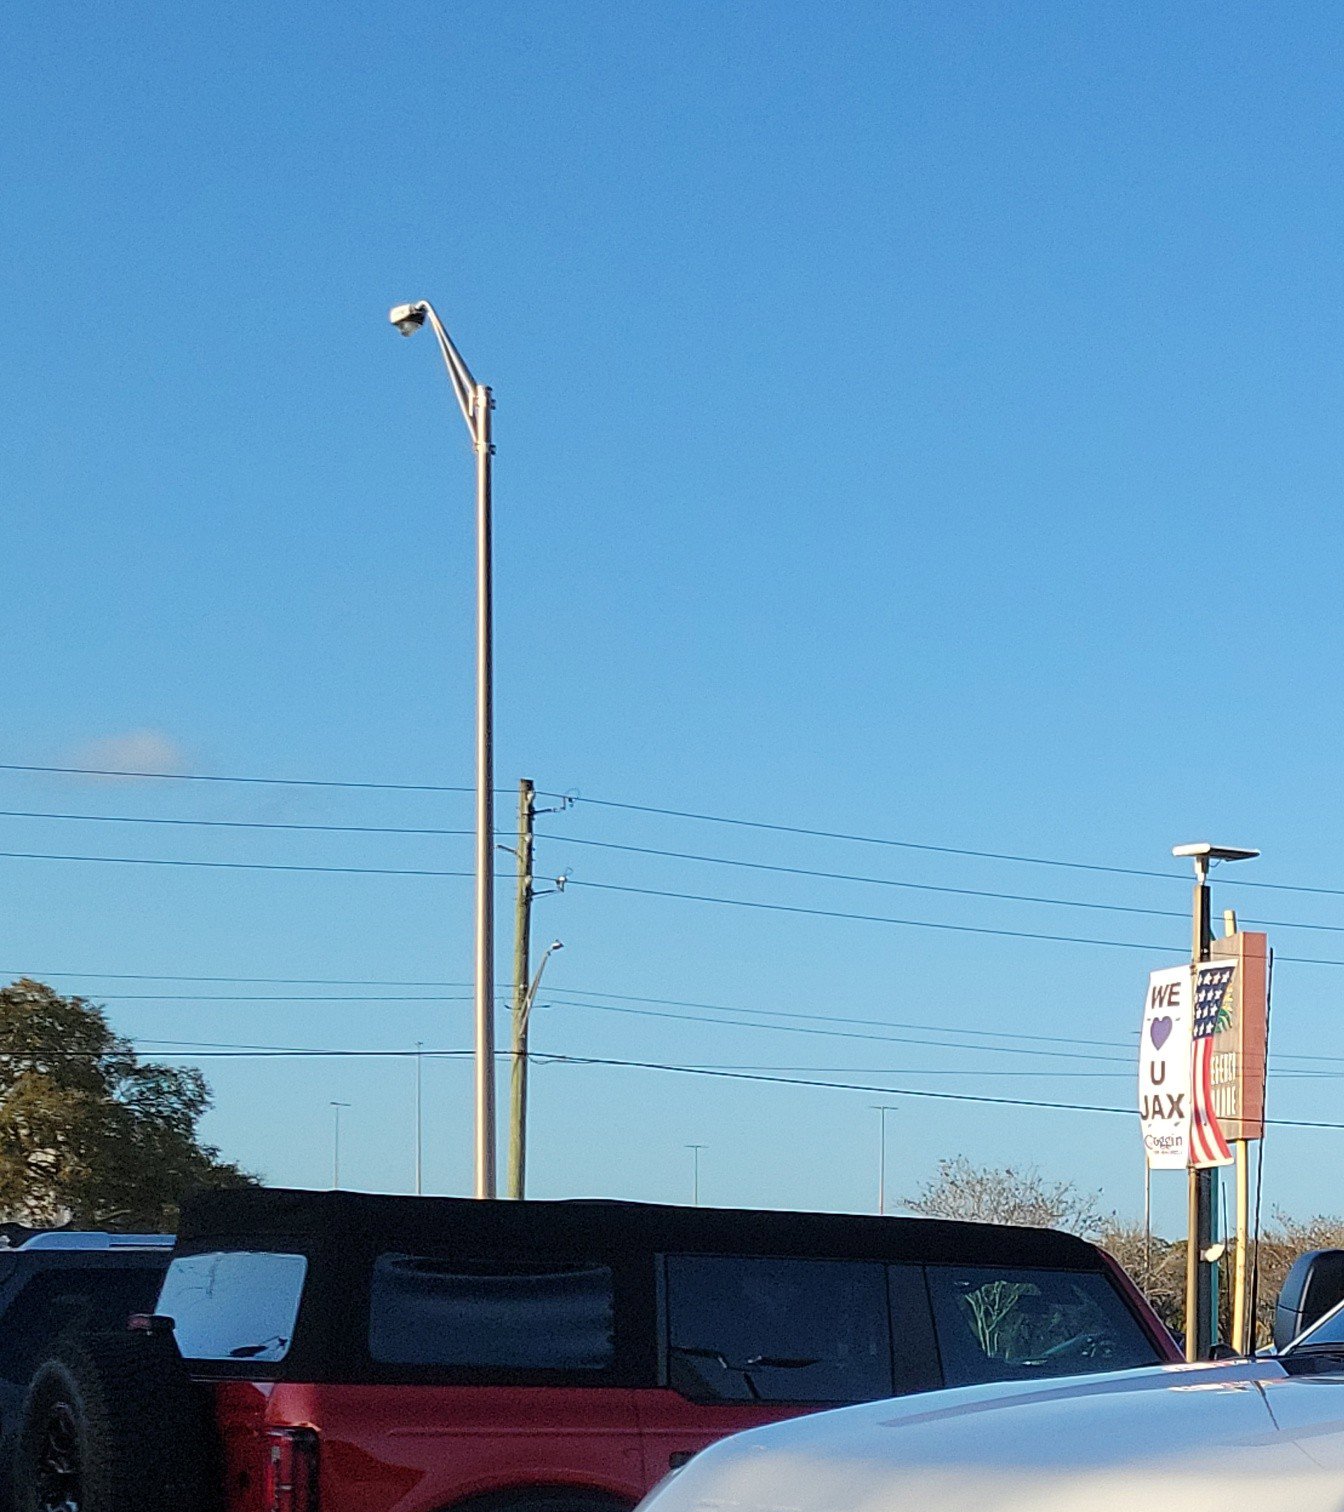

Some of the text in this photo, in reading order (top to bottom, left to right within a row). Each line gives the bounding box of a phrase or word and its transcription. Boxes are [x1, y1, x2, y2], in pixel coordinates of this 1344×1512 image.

[1151, 982, 1181, 1009] WE
[1150, 1060, 1166, 1086] U
[1140, 1093, 1186, 1121] JAX
